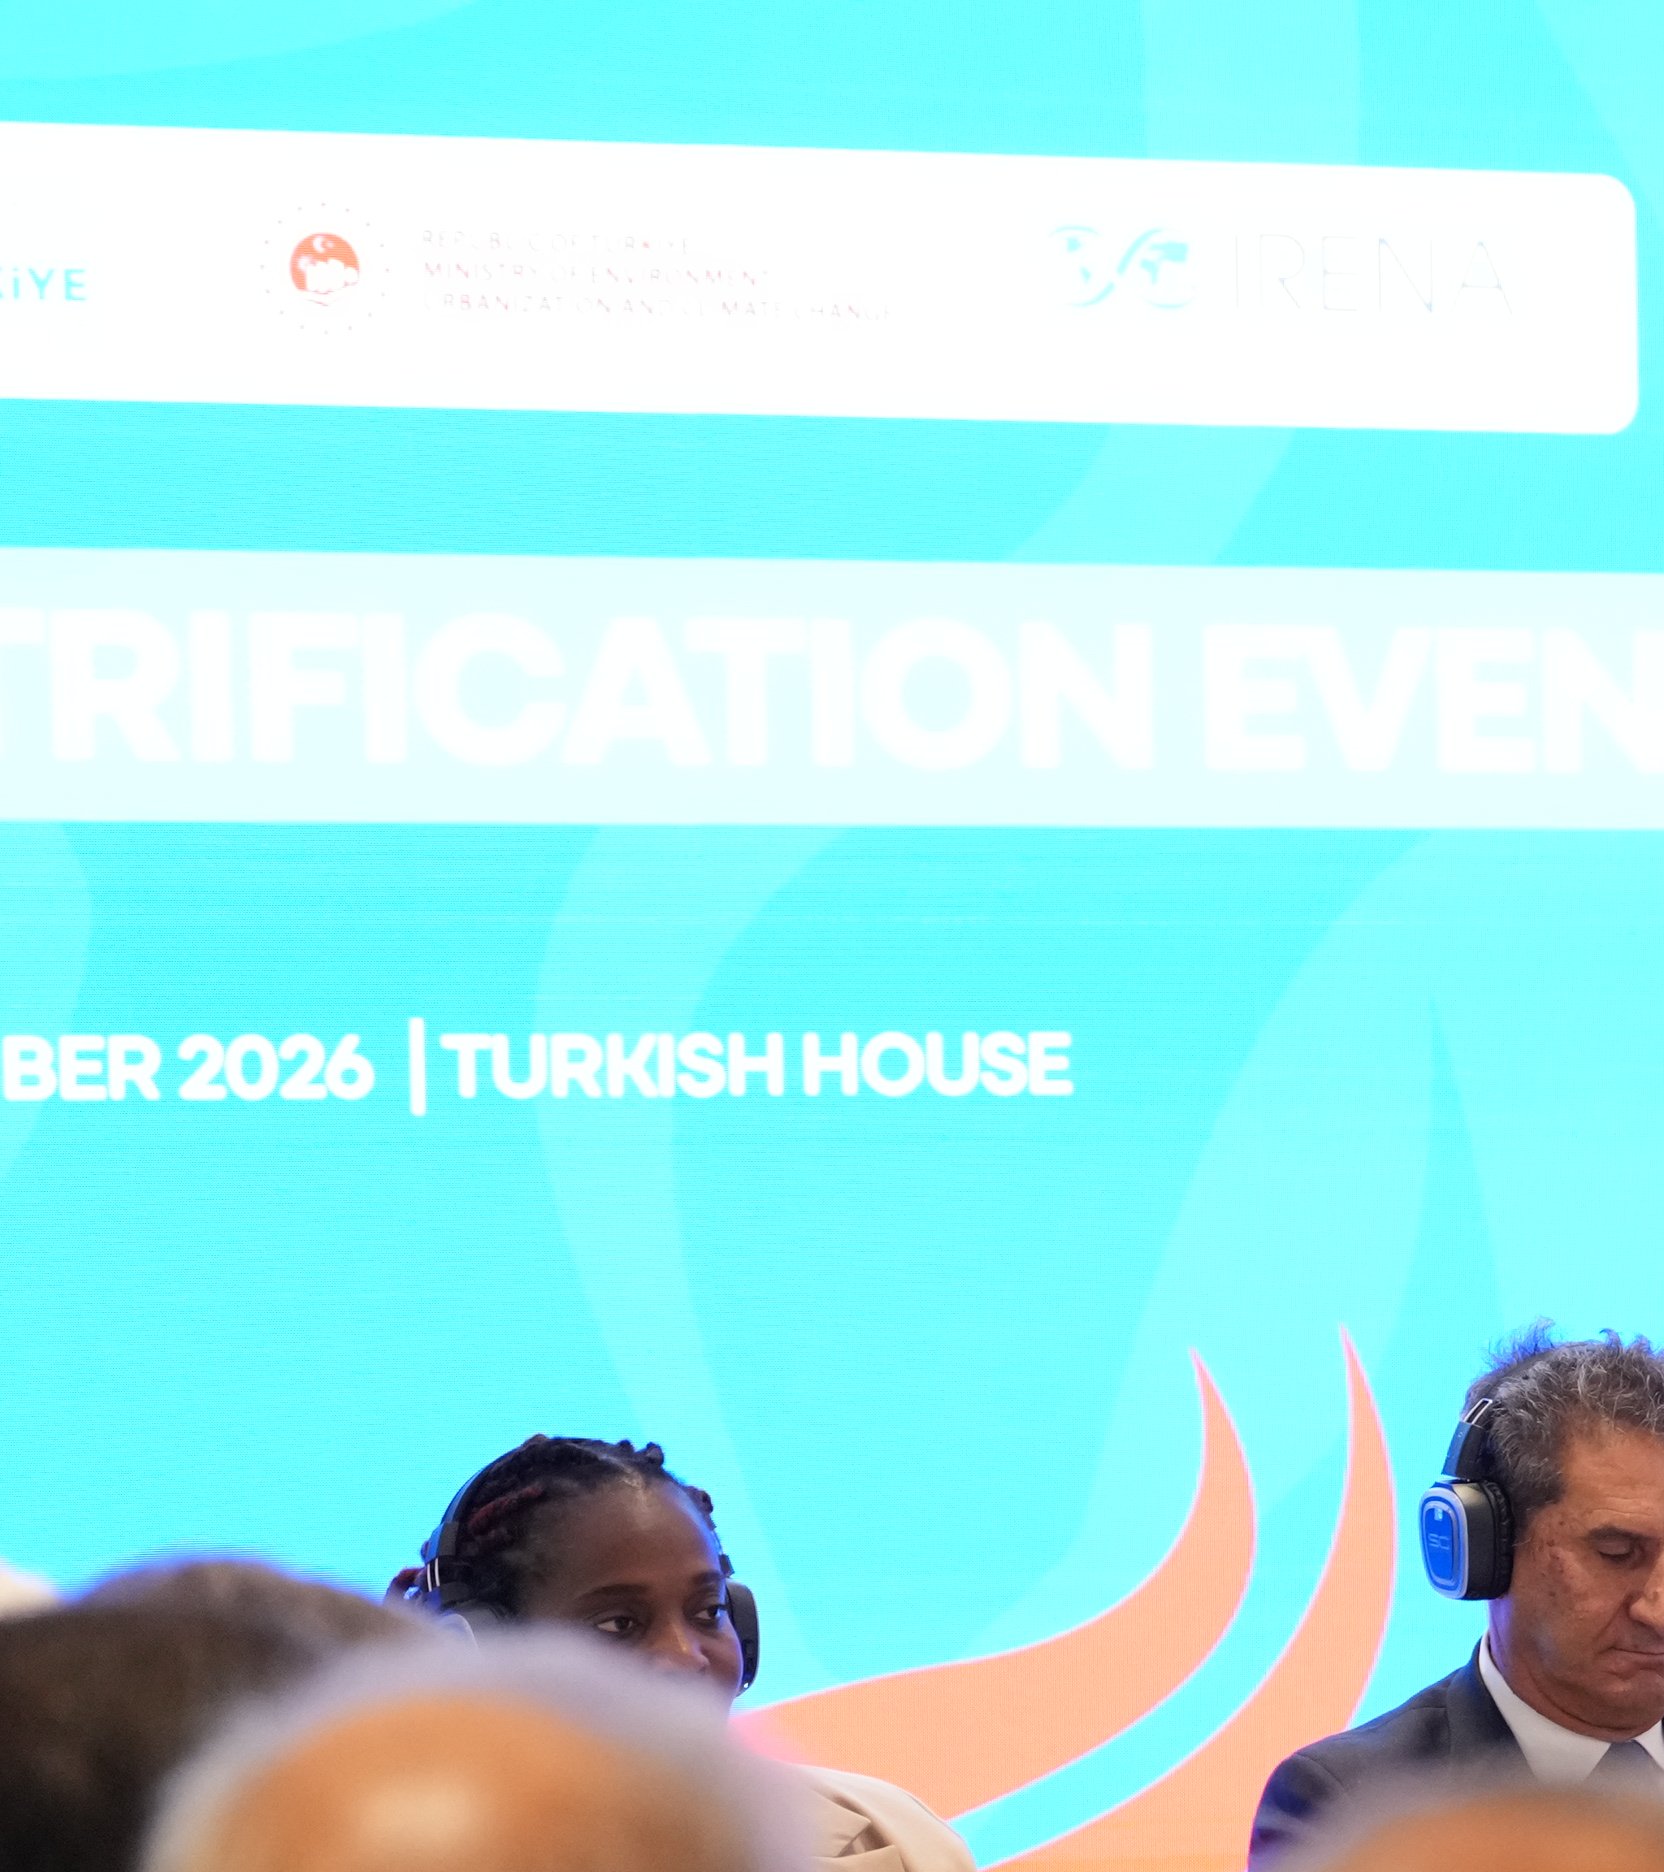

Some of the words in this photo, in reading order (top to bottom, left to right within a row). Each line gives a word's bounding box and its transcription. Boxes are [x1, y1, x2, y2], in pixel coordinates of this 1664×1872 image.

[424, 262, 537, 281] MINISRY
[1233, 232, 1514, 315] IRENA
[2, 1034, 163, 1102] BER
[177, 1033, 376, 1101] 2026
[440, 1032, 786, 1100] TURKISH
[802, 1031, 1075, 1097] HOUSE
